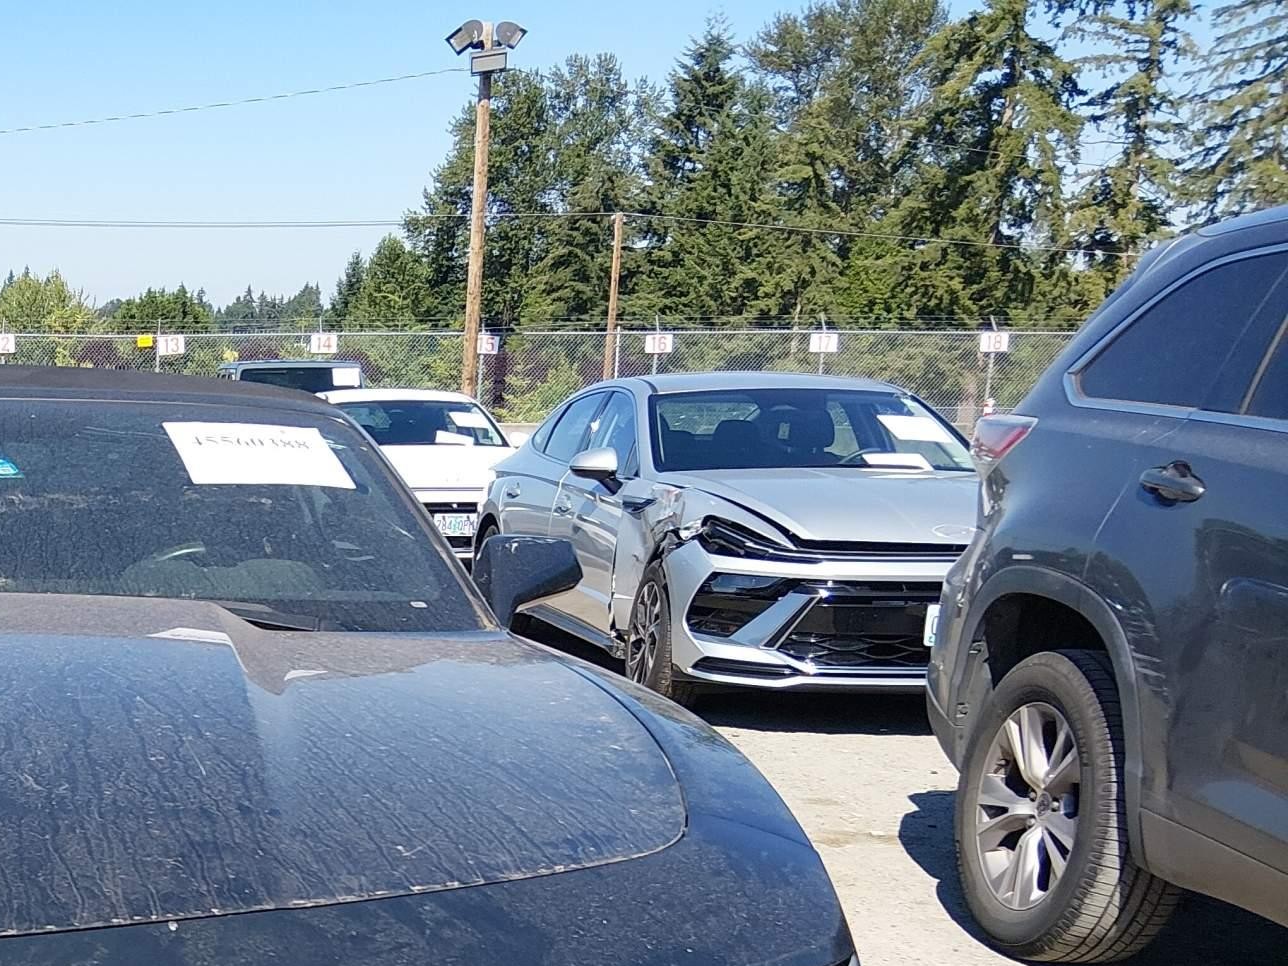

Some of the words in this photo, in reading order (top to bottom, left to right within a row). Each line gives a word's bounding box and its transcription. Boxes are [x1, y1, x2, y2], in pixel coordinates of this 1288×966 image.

[165, 337, 179, 353] 13
[317, 336, 332, 351] 14
[478, 337, 495, 352] 15
[652, 336, 667, 351] 16
[818, 335, 832, 351] 17
[987, 334, 1002, 350] 18
